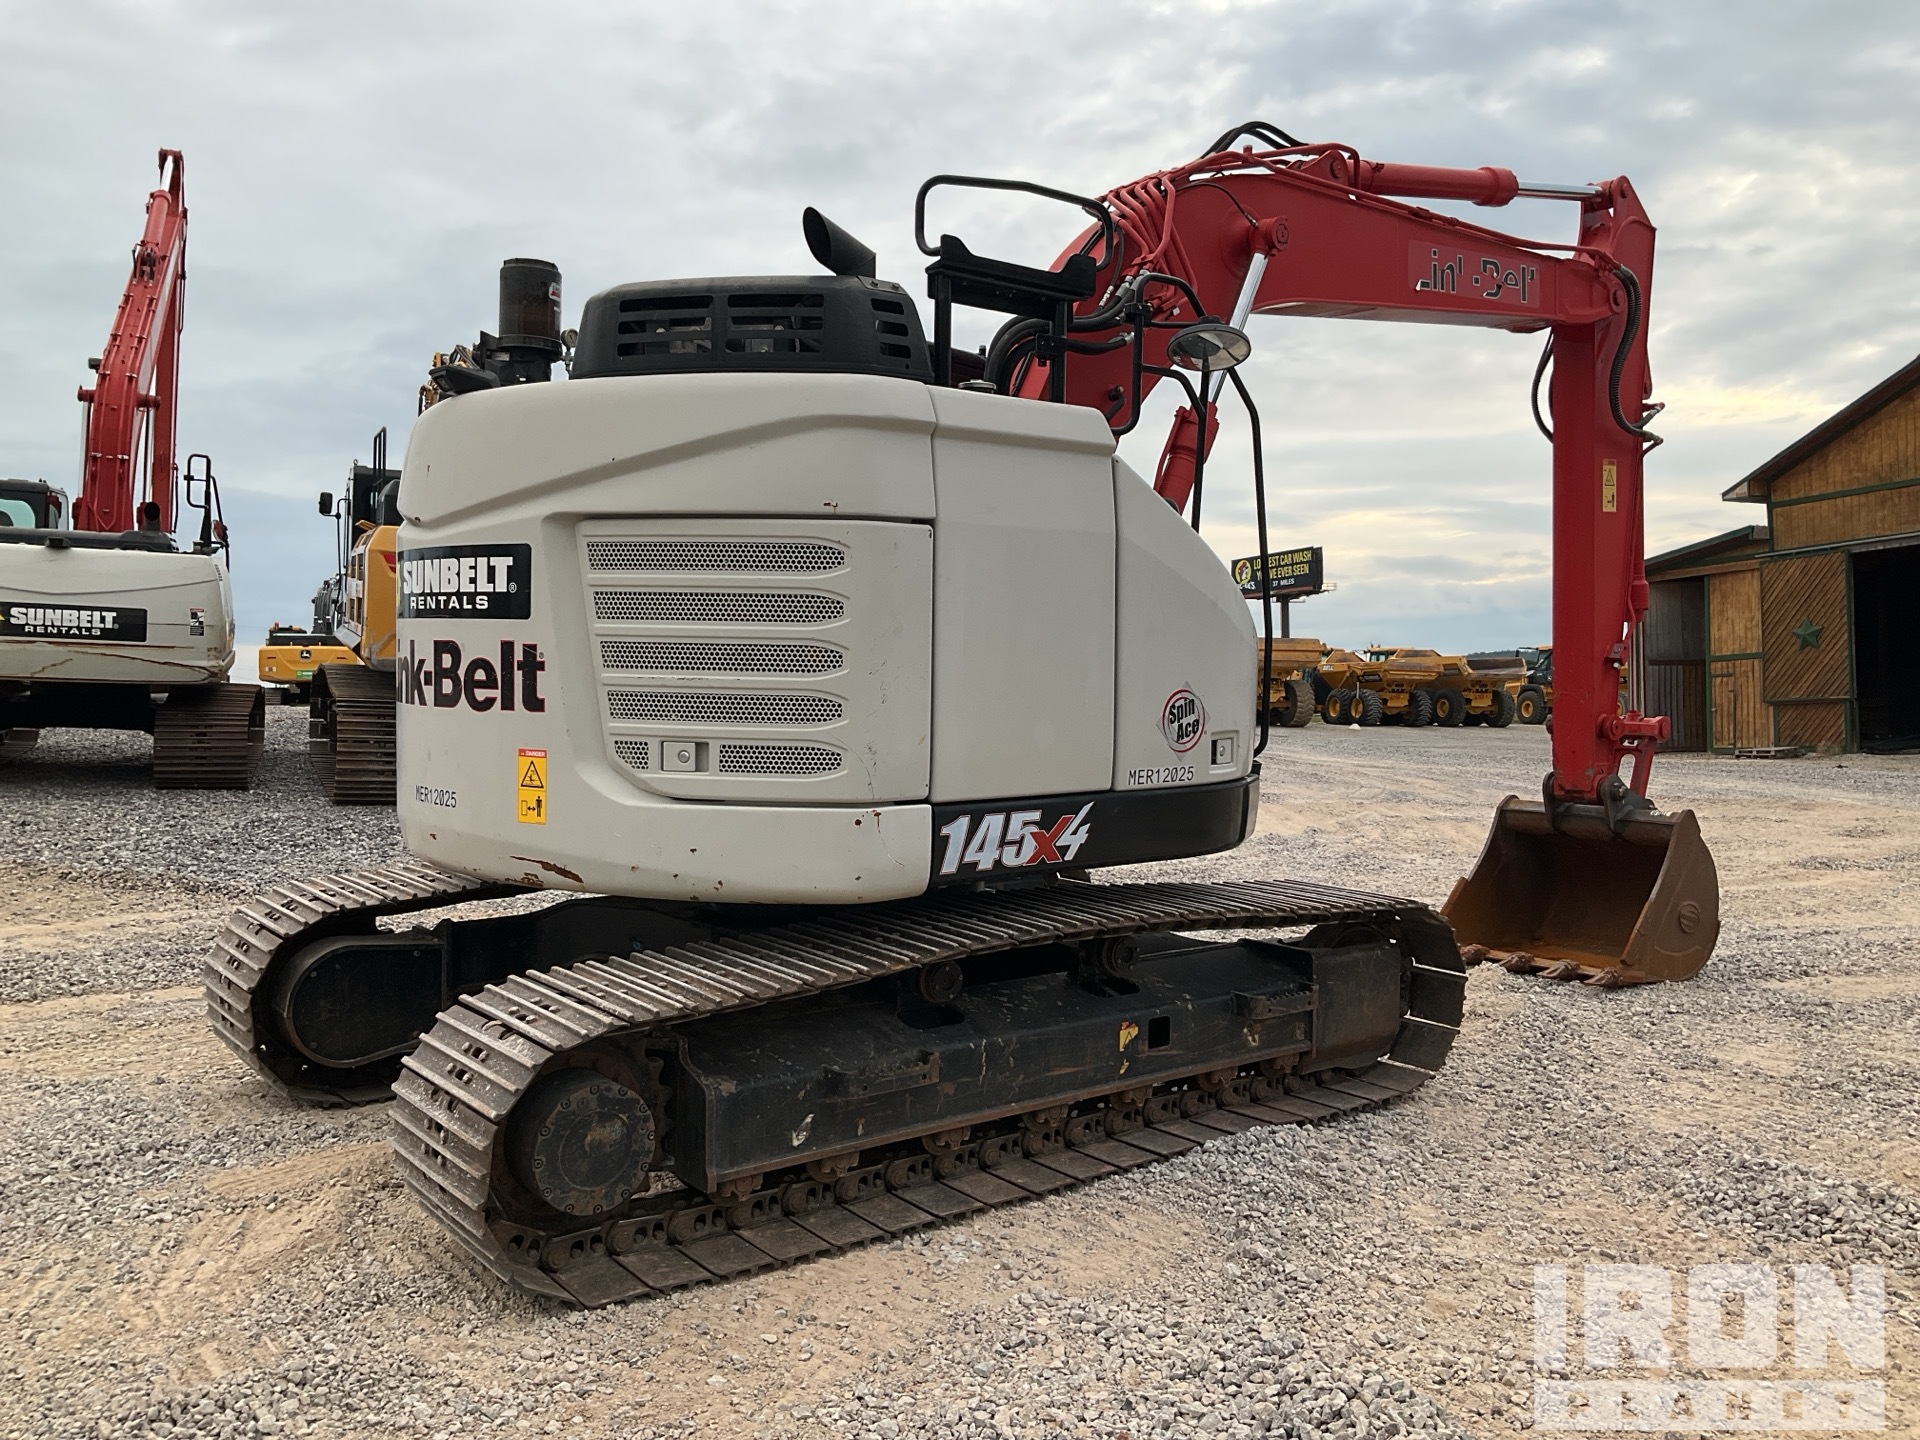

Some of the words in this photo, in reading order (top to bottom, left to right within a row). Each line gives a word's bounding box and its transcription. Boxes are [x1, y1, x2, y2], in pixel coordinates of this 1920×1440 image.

[1253, 555, 1279, 570] LOEST
[1280, 553, 1292, 565] CAR
[1293, 550, 1312, 563] WASH
[1278, 565, 1292, 578] EVER
[1293, 563, 1309, 576] SEEN
[403, 556, 514, 594] SUNBELT
[1280, 578, 1295, 586] MILES
[410, 595, 489, 610] RENTALS
[10, 607, 117, 628] SUNBELT
[24, 625, 101, 635] RENTALS
[1169, 698, 1195, 724] Spin
[1176, 718, 1200, 743] Ace
[1128, 765, 1194, 786] MER12025
[415, 784, 457, 808] MER12025
